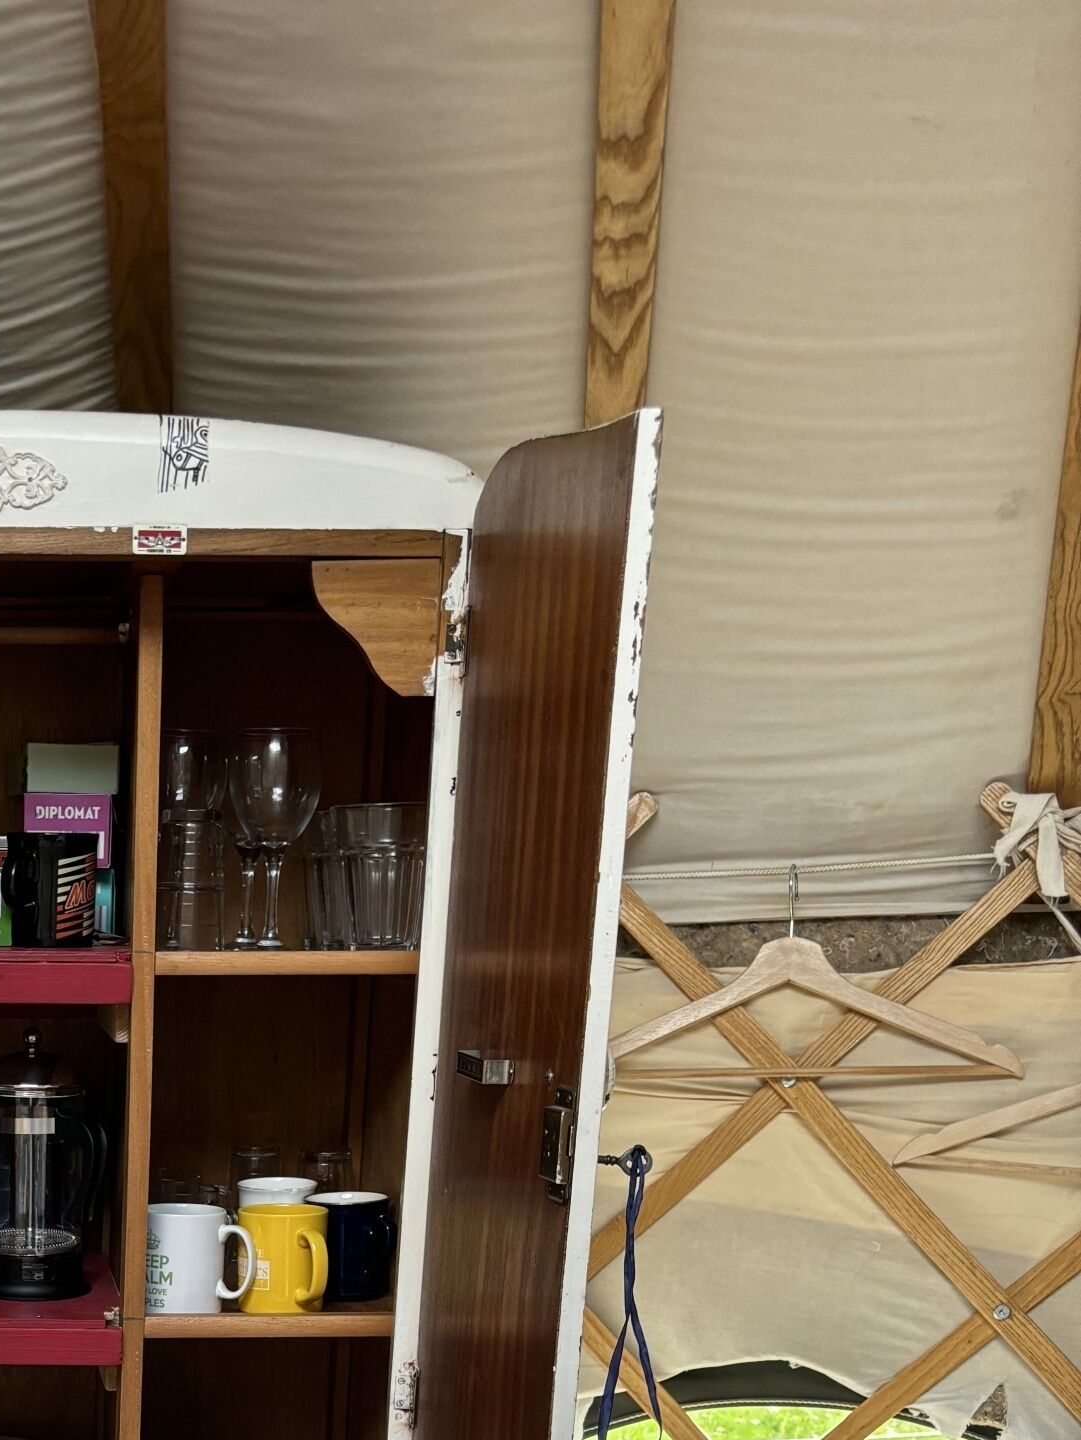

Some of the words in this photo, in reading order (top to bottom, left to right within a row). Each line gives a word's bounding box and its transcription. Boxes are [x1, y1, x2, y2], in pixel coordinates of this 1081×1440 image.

[35, 805, 101, 820] DIPLOMAT
[148, 1287, 168, 1296] LOVE
[144, 1297, 165, 1308] PLES
